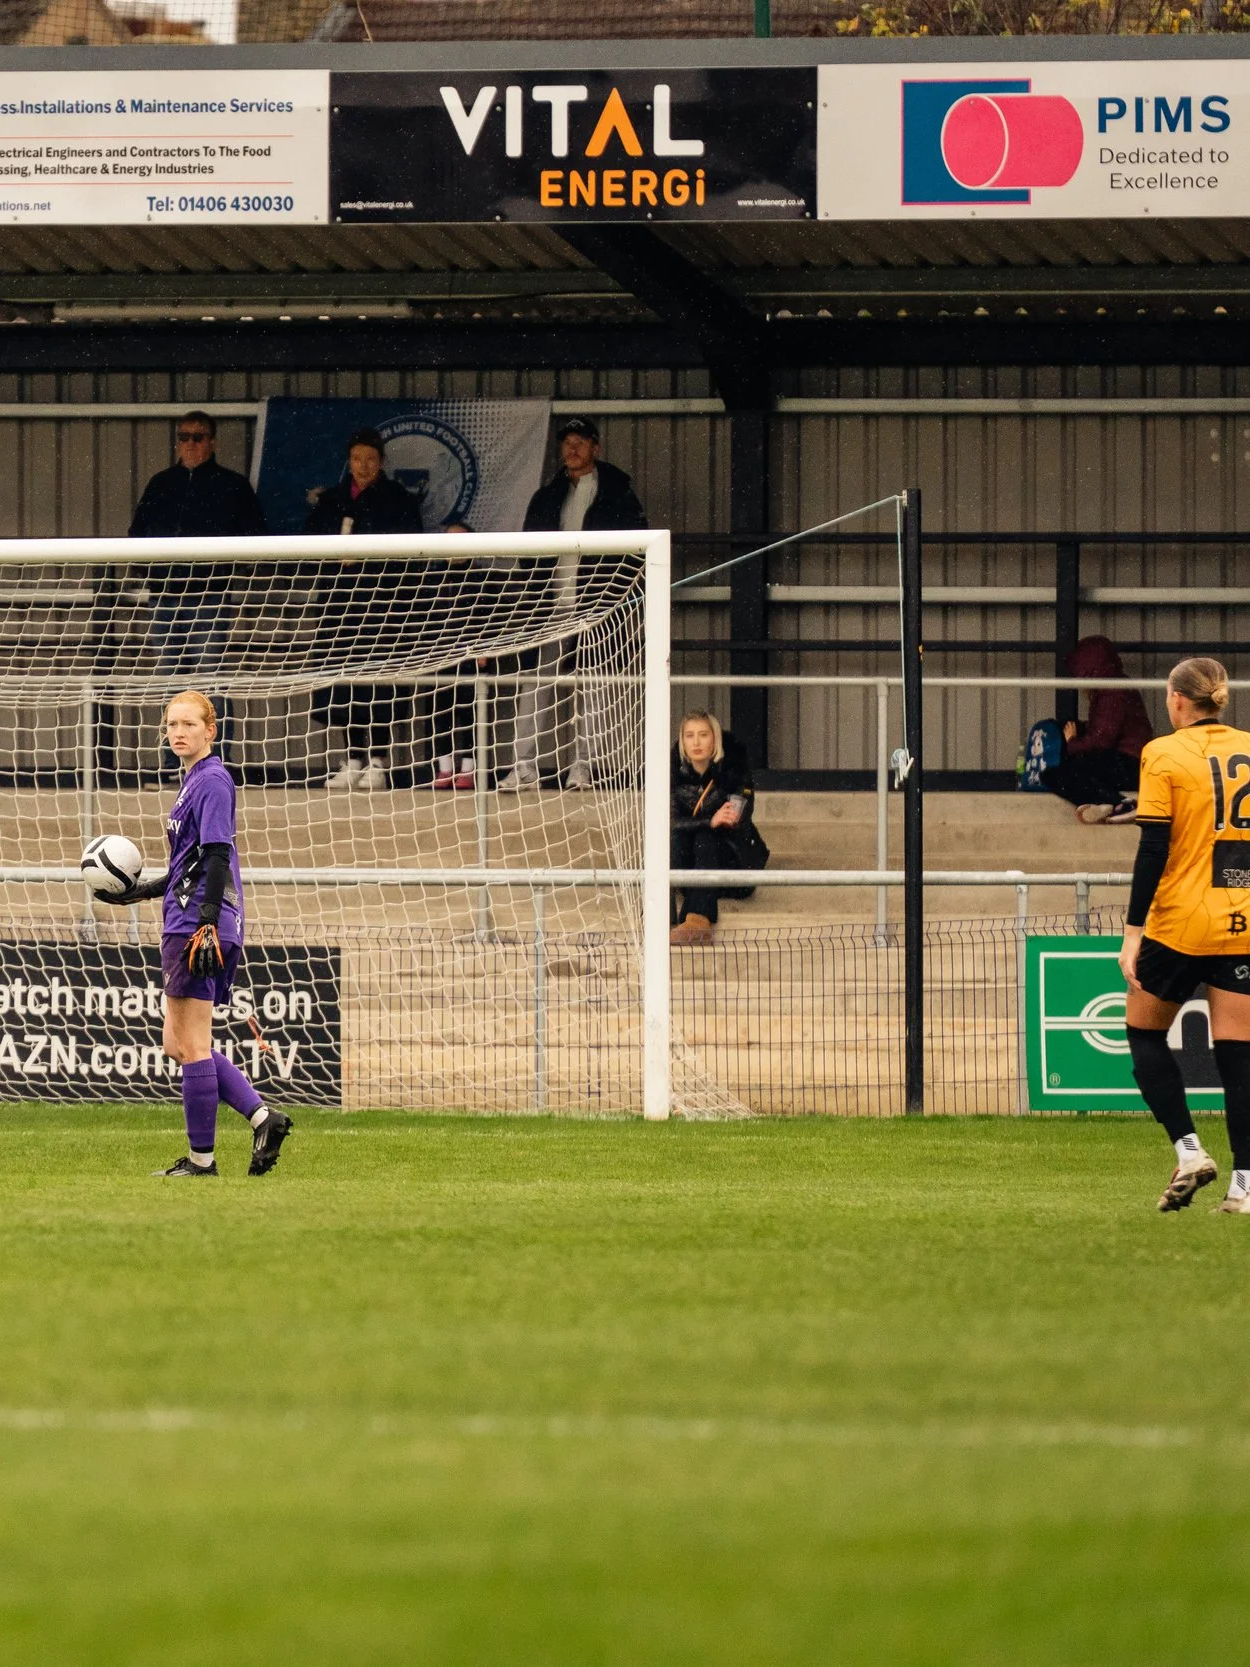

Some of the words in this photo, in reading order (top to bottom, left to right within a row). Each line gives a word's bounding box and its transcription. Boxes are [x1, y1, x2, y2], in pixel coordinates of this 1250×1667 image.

[20, 98, 111, 114] Installations
[115, 99, 127, 114] &
[130, 98, 226, 113] Maintenance
[230, 98, 293, 113] Services
[1097, 95, 1231, 134] PIMS
[439, 84, 705, 158] VITAL
[45, 147, 103, 161] Engineers
[105, 147, 127, 158] and
[130, 146, 200, 158] Contractors
[203, 146, 216, 157] To
[219, 146, 239, 157] The
[242, 146, 271, 157] Food
[1099, 147, 1203, 165] Dedicated
[1209, 148, 1229, 164] to
[34, 163, 98, 175] Healthcare
[100, 163, 110, 174] &
[112, 163, 152, 177] Energy
[155, 162, 214, 174] Industries
[1110, 173, 1219, 190] Excellence
[147, 196, 174, 212] Tel:
[178, 196, 227, 212] 01406
[230, 196, 293, 211] 430030
[393, 421, 435, 435] UNITED
[1208, 753, 1250, 831] 12
[84, 979, 254, 1021] mats
[263, 988, 313, 1021] on
